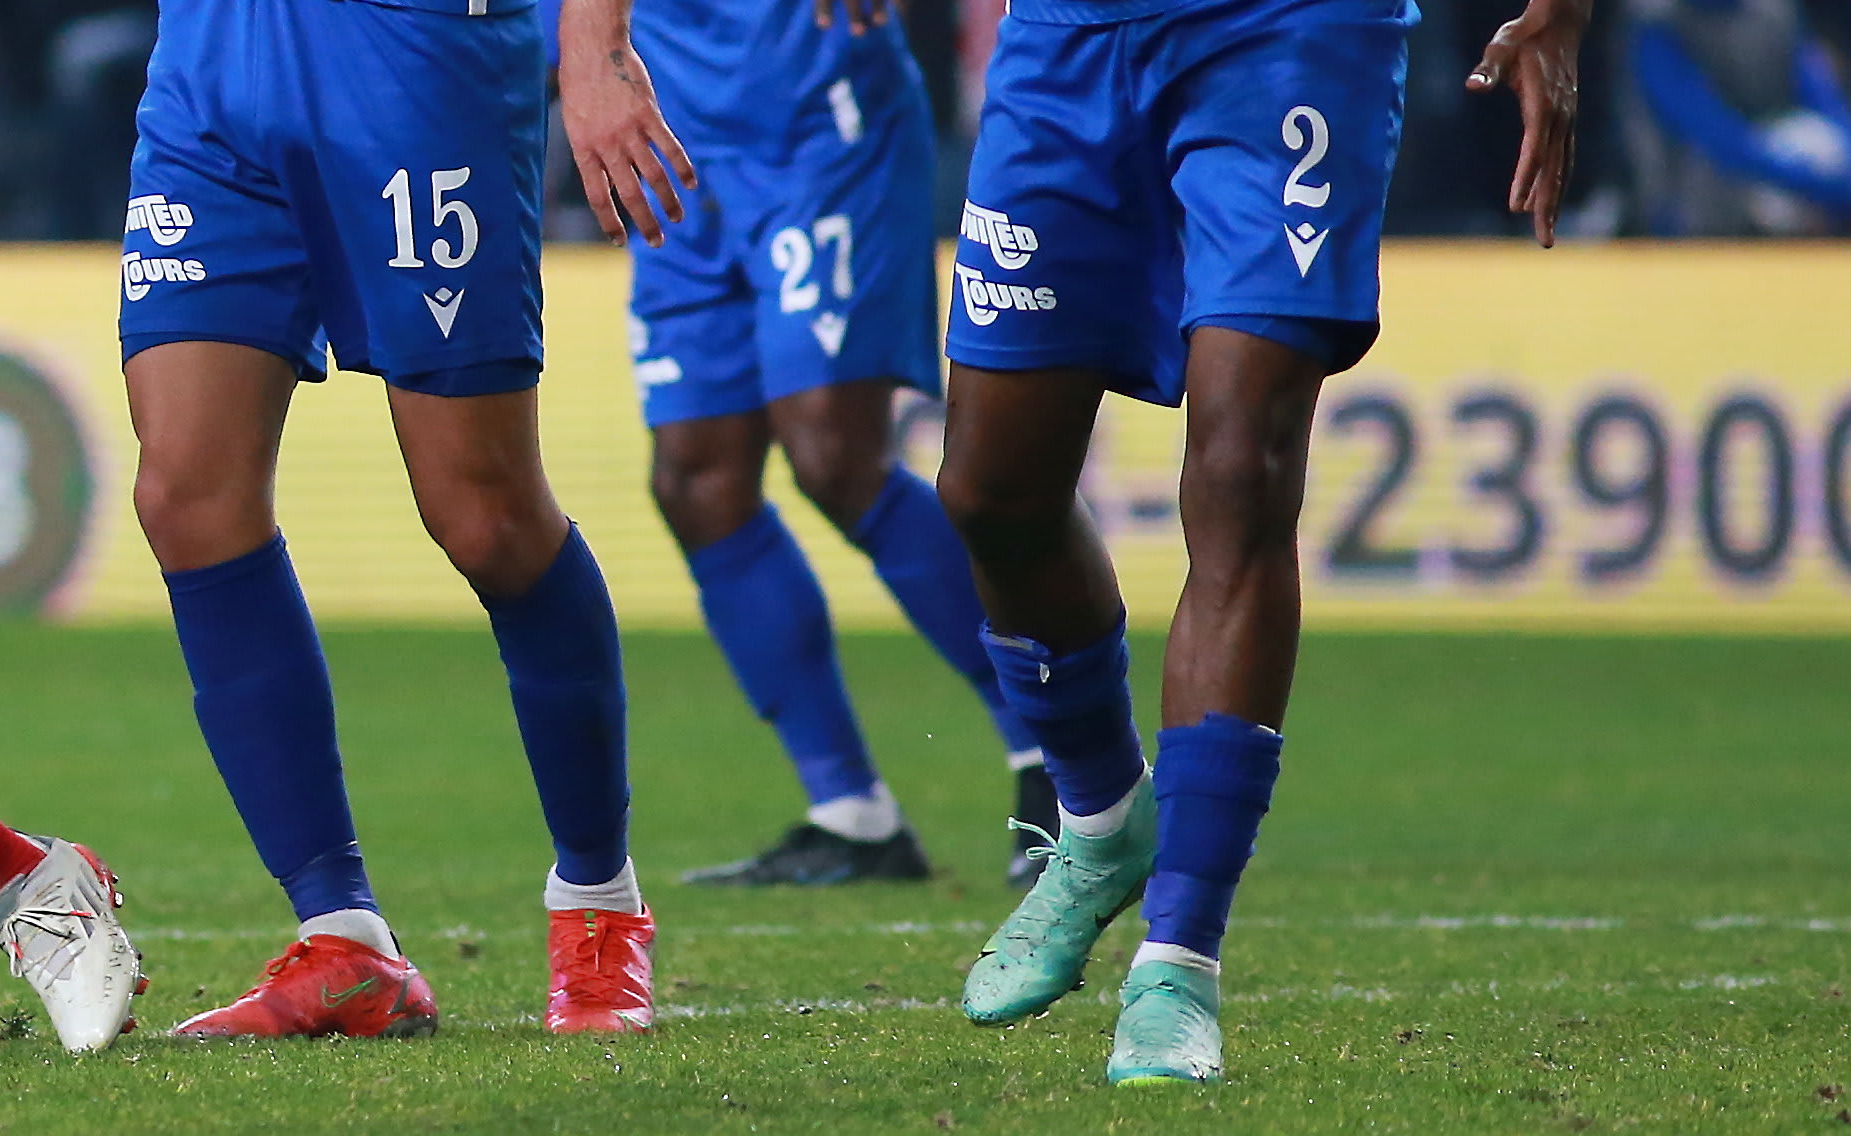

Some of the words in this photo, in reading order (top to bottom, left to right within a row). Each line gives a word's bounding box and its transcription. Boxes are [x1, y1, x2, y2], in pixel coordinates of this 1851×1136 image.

[1281, 105, 1331, 208] 2
[124, 194, 195, 247] NITED
[380, 166, 479, 269] 15
[770, 214, 854, 314] 27
[121, 251, 207, 302] TOURS
[955, 261, 1058, 327] TOURS
[1322, 386, 1851, 582] 2390
